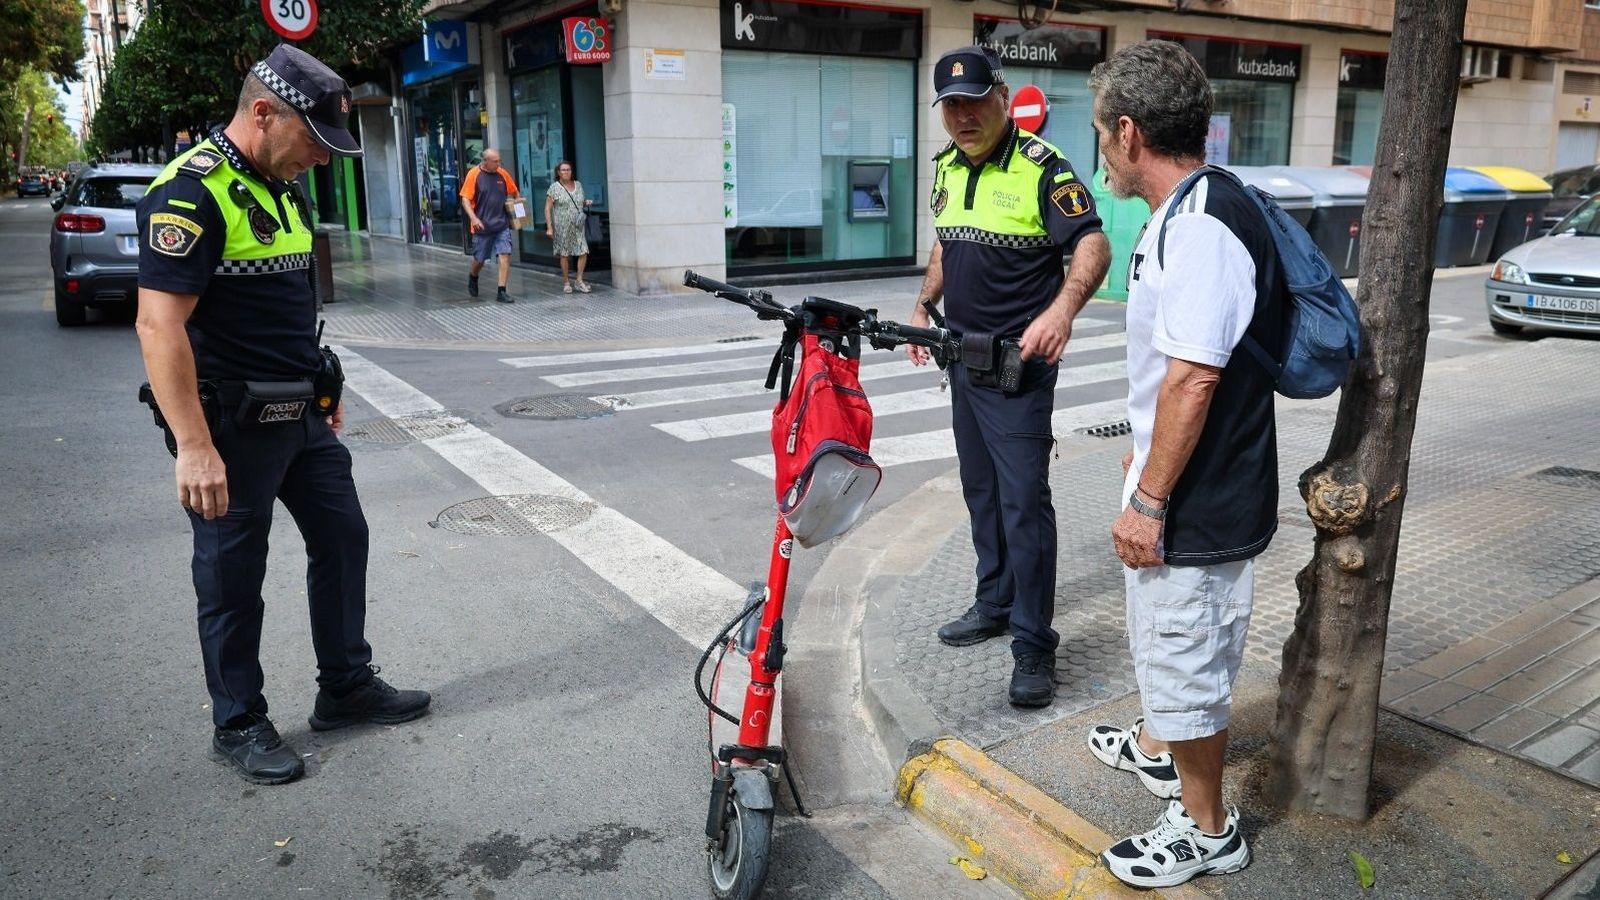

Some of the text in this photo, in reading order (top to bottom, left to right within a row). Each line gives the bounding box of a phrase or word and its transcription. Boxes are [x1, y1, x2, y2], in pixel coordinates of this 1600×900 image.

[278, 0, 305, 20] 30
[735, 2, 756, 41] k
[574, 52, 591, 60] EURO
[1237, 57, 1296, 77] kutxabank
[992, 190, 1021, 203] POLICIA
[993, 198, 1016, 210] LOCAL
[1536, 296, 1594, 311] IB 4106 DS
